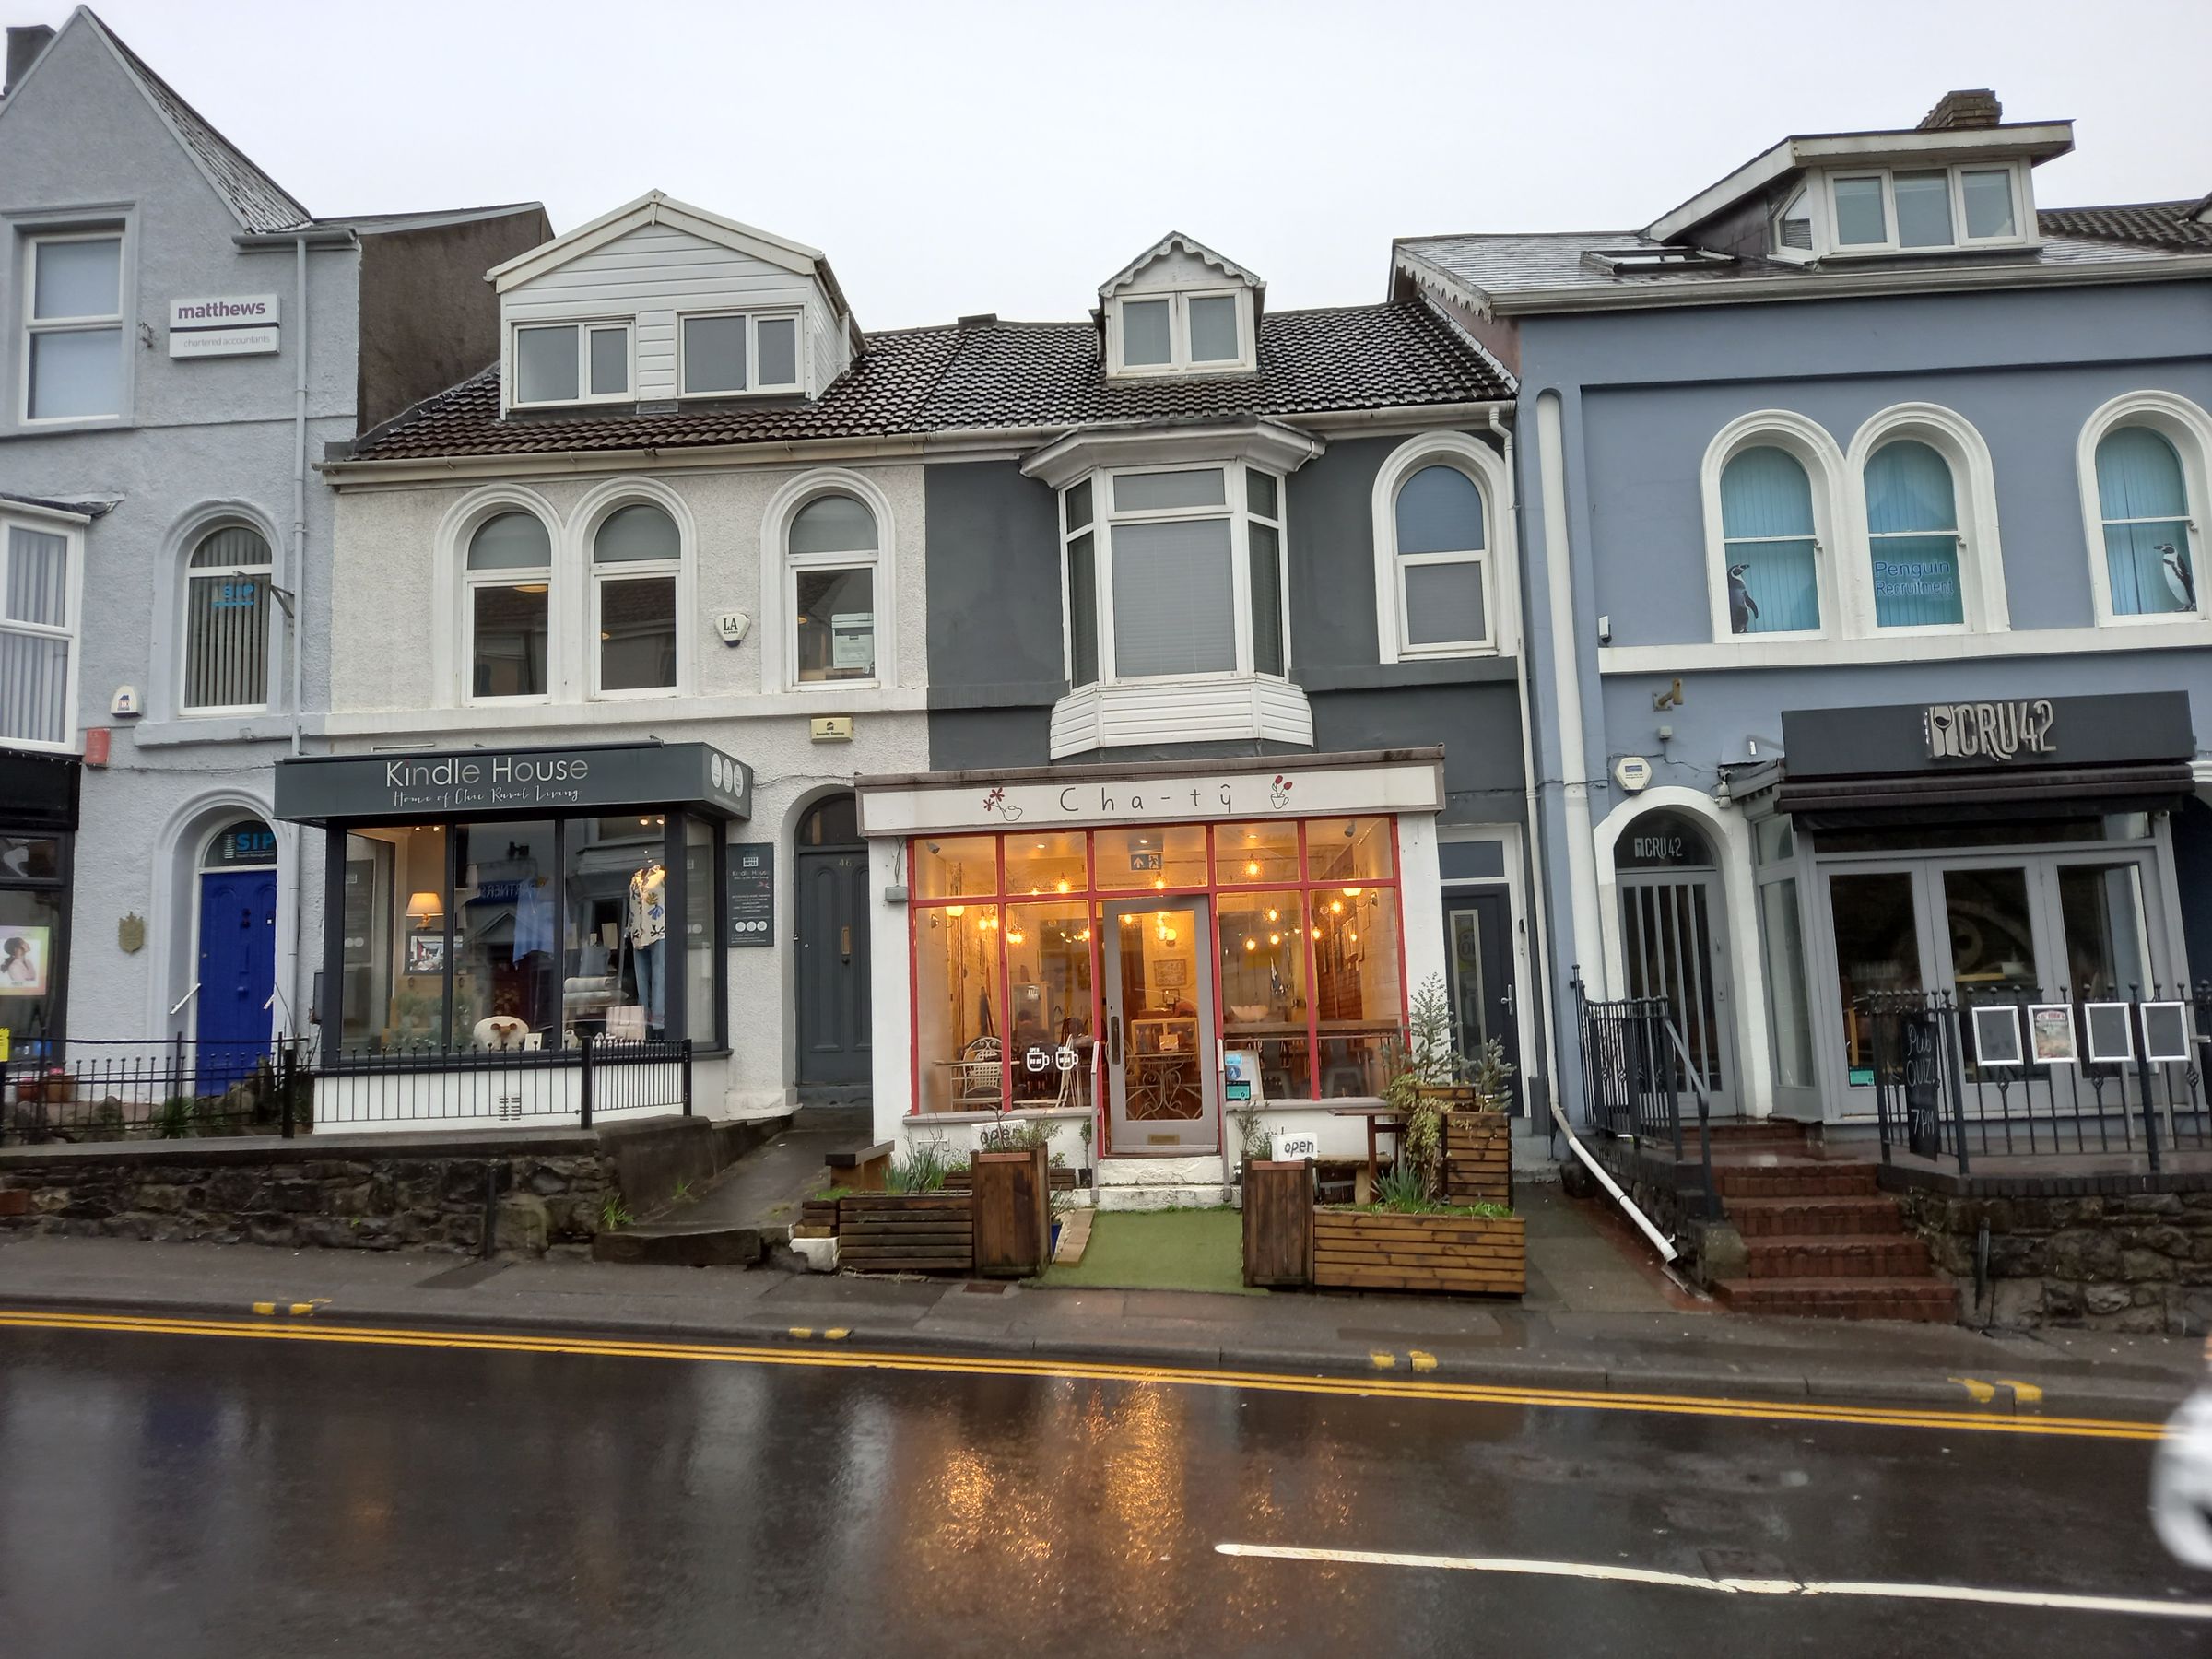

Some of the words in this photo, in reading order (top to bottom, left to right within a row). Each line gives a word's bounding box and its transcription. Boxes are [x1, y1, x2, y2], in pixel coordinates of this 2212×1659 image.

[177, 301, 265, 319] matthews
[183, 335, 221, 347] chartered
[222, 335, 271, 346] accountants
[1875, 559, 1950, 578] Penguin
[1876, 579, 1954, 596] Recruitment
[723, 618, 739, 631] LA
[385, 758, 481, 787] Kindle
[492, 757, 589, 782] House
[393, 790, 432, 807] Home
[437, 790, 451, 808] of
[490, 786, 530, 804] Rural
[535, 784, 581, 802] Living
[236, 833, 275, 851] SIP
[1907, 1024, 1932, 1056] Pub
[1284, 1141, 1314, 1158] open
